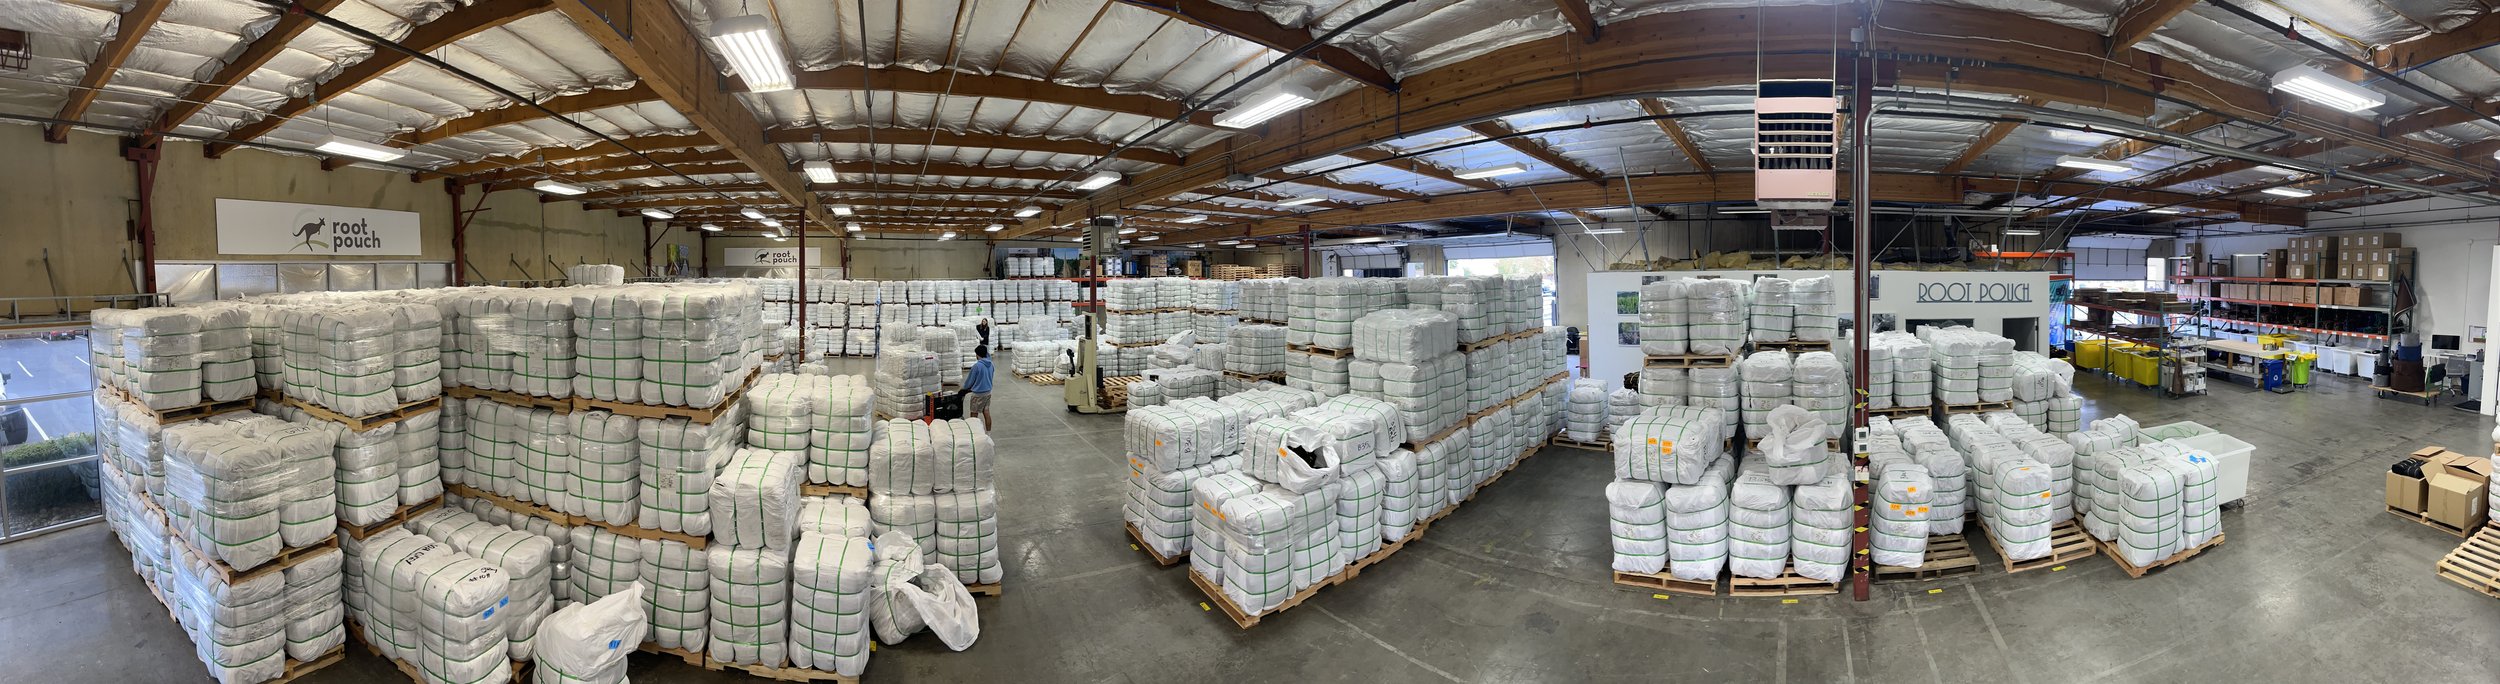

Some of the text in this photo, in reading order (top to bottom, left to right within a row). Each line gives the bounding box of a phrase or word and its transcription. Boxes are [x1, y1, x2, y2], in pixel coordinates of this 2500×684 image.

[333, 218, 367, 235] root
[334, 230, 381, 252] pouch
[773, 255, 797, 264] pouch
[1917, 282, 1973, 302] ROOT
[1976, 282, 2032, 302] POUCH
